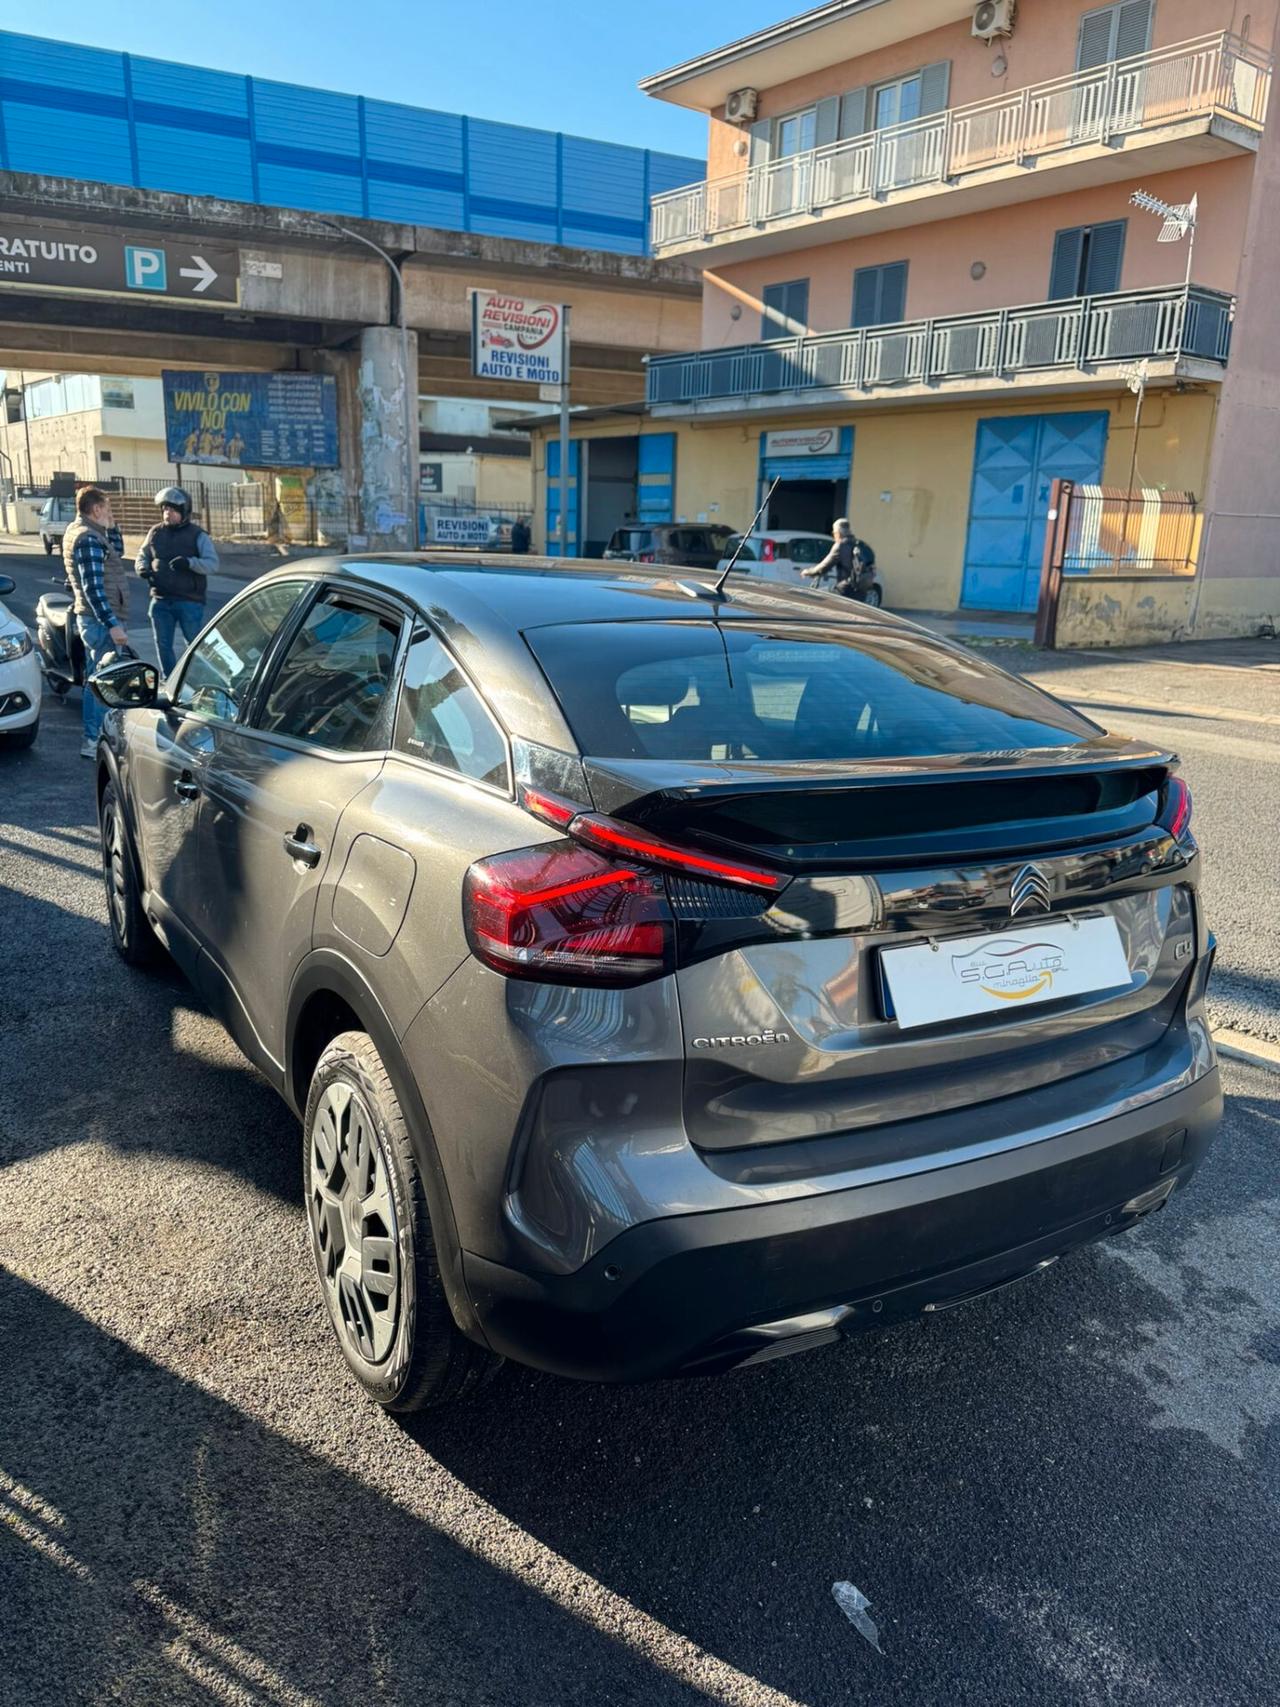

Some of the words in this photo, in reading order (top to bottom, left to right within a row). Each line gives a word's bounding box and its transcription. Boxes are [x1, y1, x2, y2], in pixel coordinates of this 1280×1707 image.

[486, 296, 524, 312] AUTO
[482, 309, 551, 328] REVISIONI
[504, 323, 543, 336] CAMPANIA
[491, 350, 549, 369] REVISIONI
[481, 362, 512, 377] AUTO
[516, 366, 524, 378] E
[527, 367, 559, 382] MOTO
[174, 390, 219, 412] VIVILO
[221, 391, 251, 413] CON
[201, 410, 227, 430] NOI
[436, 519, 489, 532] REVISIONI
[436, 530, 459, 540] AUTO
[467, 532, 488, 541] MOTO
